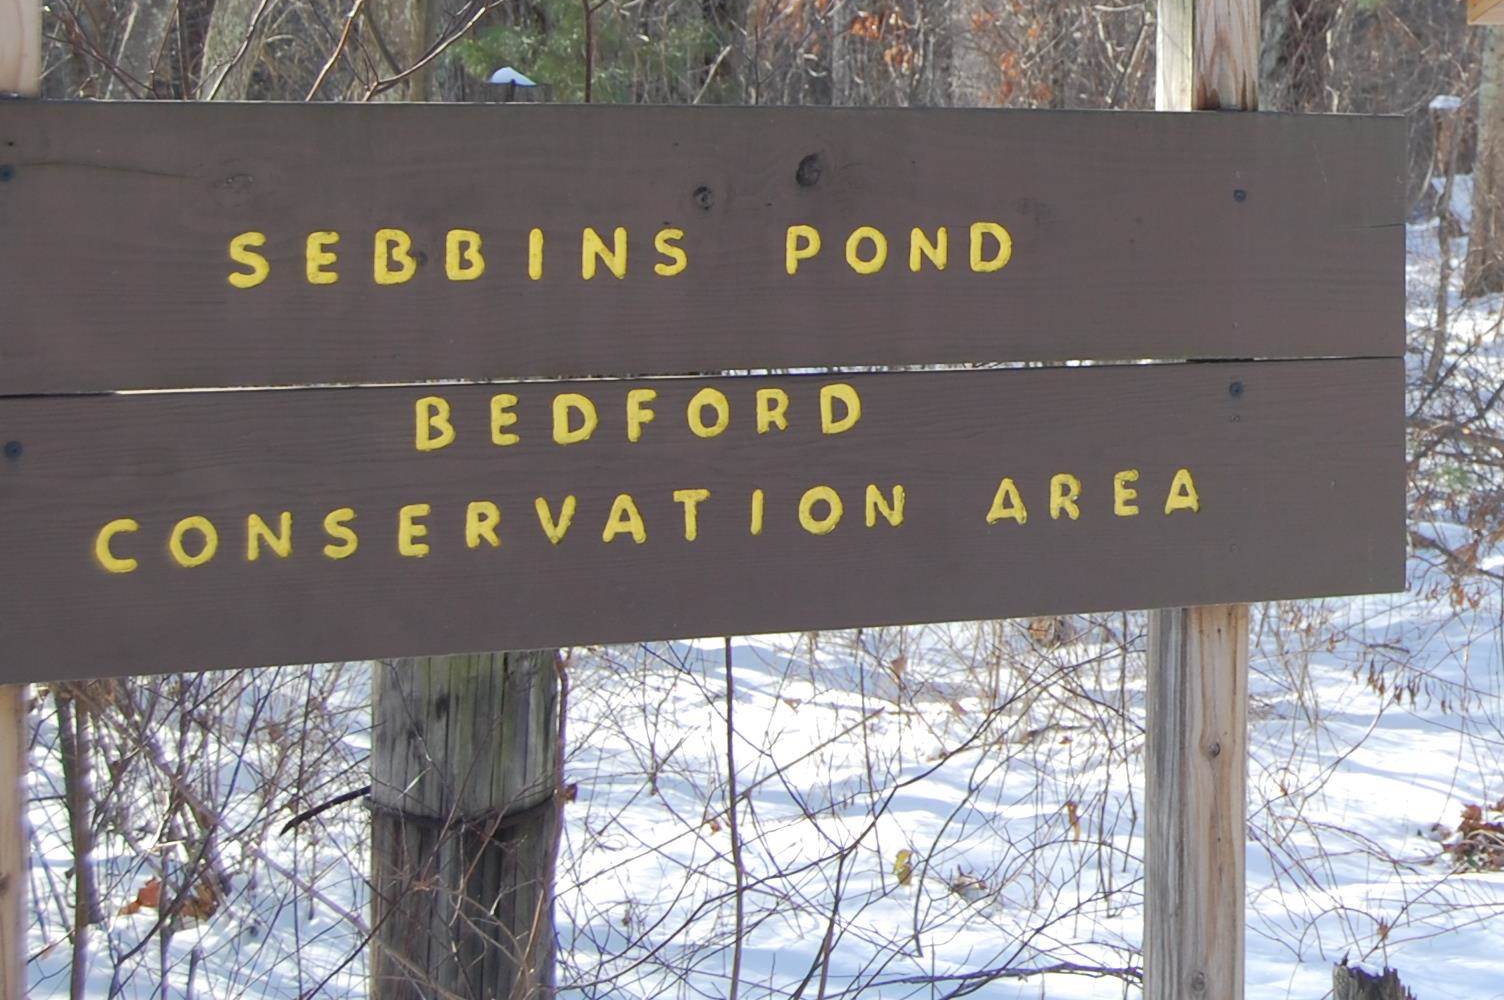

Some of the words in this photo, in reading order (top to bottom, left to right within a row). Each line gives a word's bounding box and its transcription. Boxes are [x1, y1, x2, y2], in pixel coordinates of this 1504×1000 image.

[227, 226, 690, 289] SEBBINS
[785, 221, 1014, 277] POND
[415, 382, 863, 452] BEDFORD
[94, 482, 907, 573] CONSERVATION
[986, 467, 1202, 525] AREA
